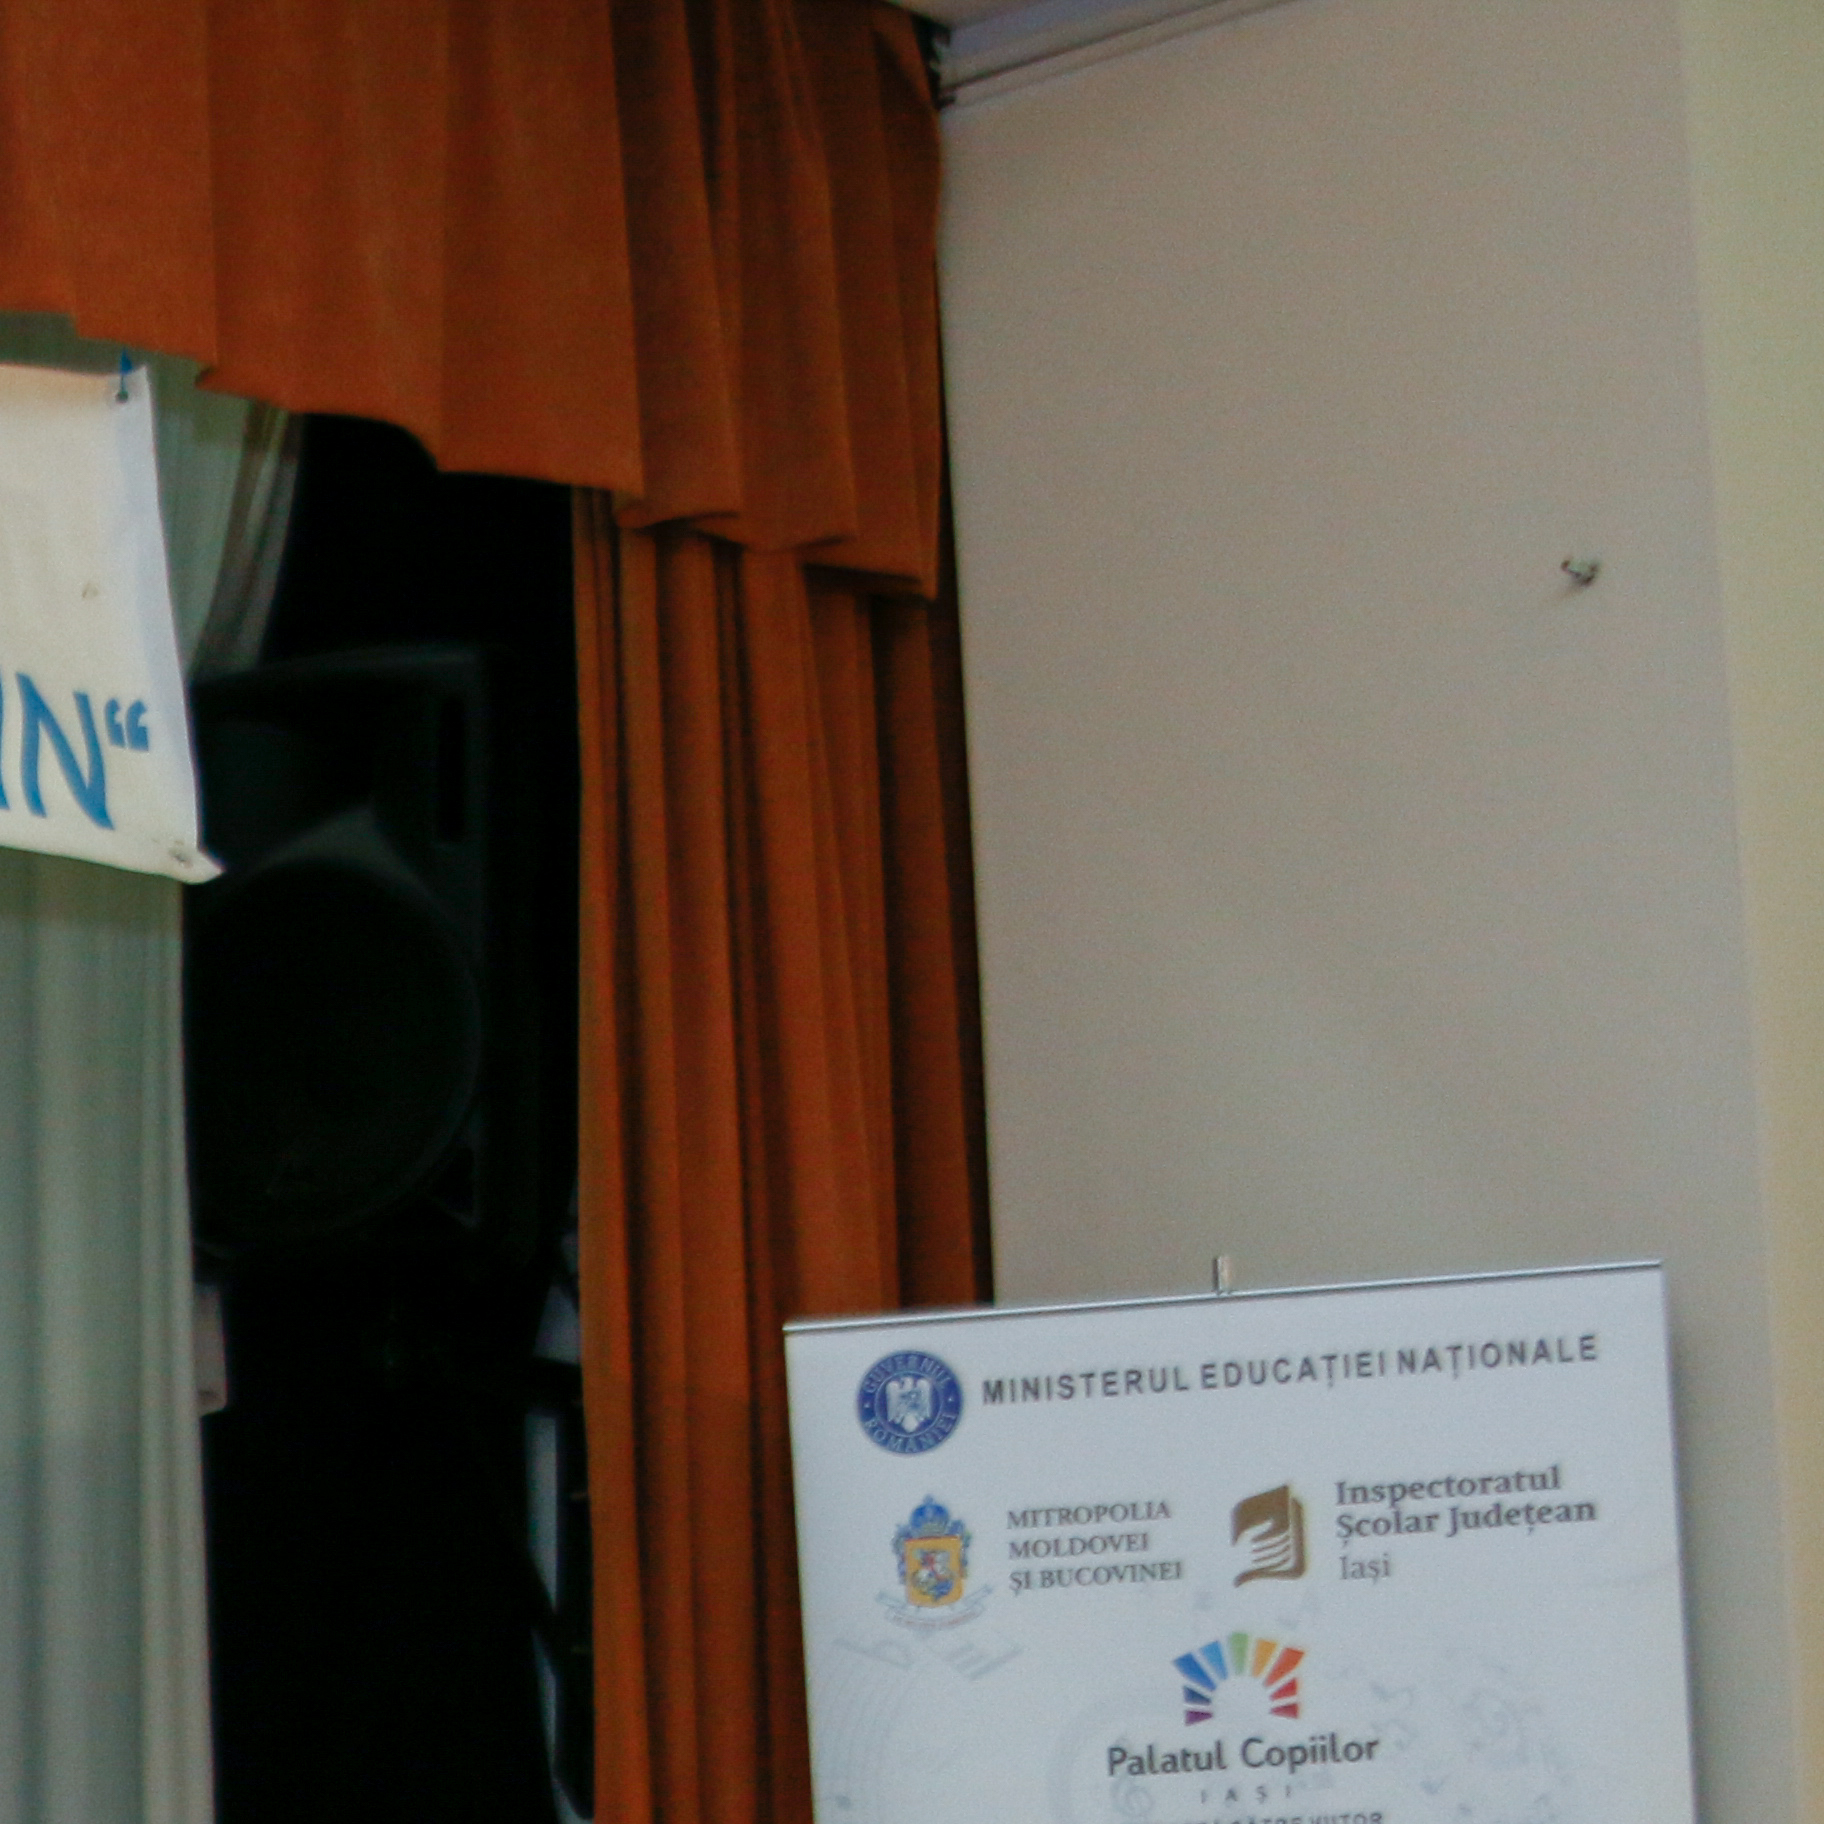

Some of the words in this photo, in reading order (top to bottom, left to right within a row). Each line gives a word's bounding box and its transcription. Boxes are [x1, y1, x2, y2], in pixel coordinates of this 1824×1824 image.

[982, 1366, 1190, 1406] MINISTERUL
[1200, 1350, 1387, 1390] EDUCAȚIEI
[1396, 1334, 1598, 1380] NAȚIONALE
[1333, 1464, 1562, 1509] Inspectoratul
[1006, 1500, 1172, 1530] MITROPOLIA
[1446, 1500, 1598, 1537] Județean
[1007, 1532, 1150, 1560] MOLDOVEI
[1040, 1560, 1184, 1591] BUCOVINEI
[1107, 1740, 1227, 1777] Palatul
[1241, 1732, 1380, 1775] Copiilor
